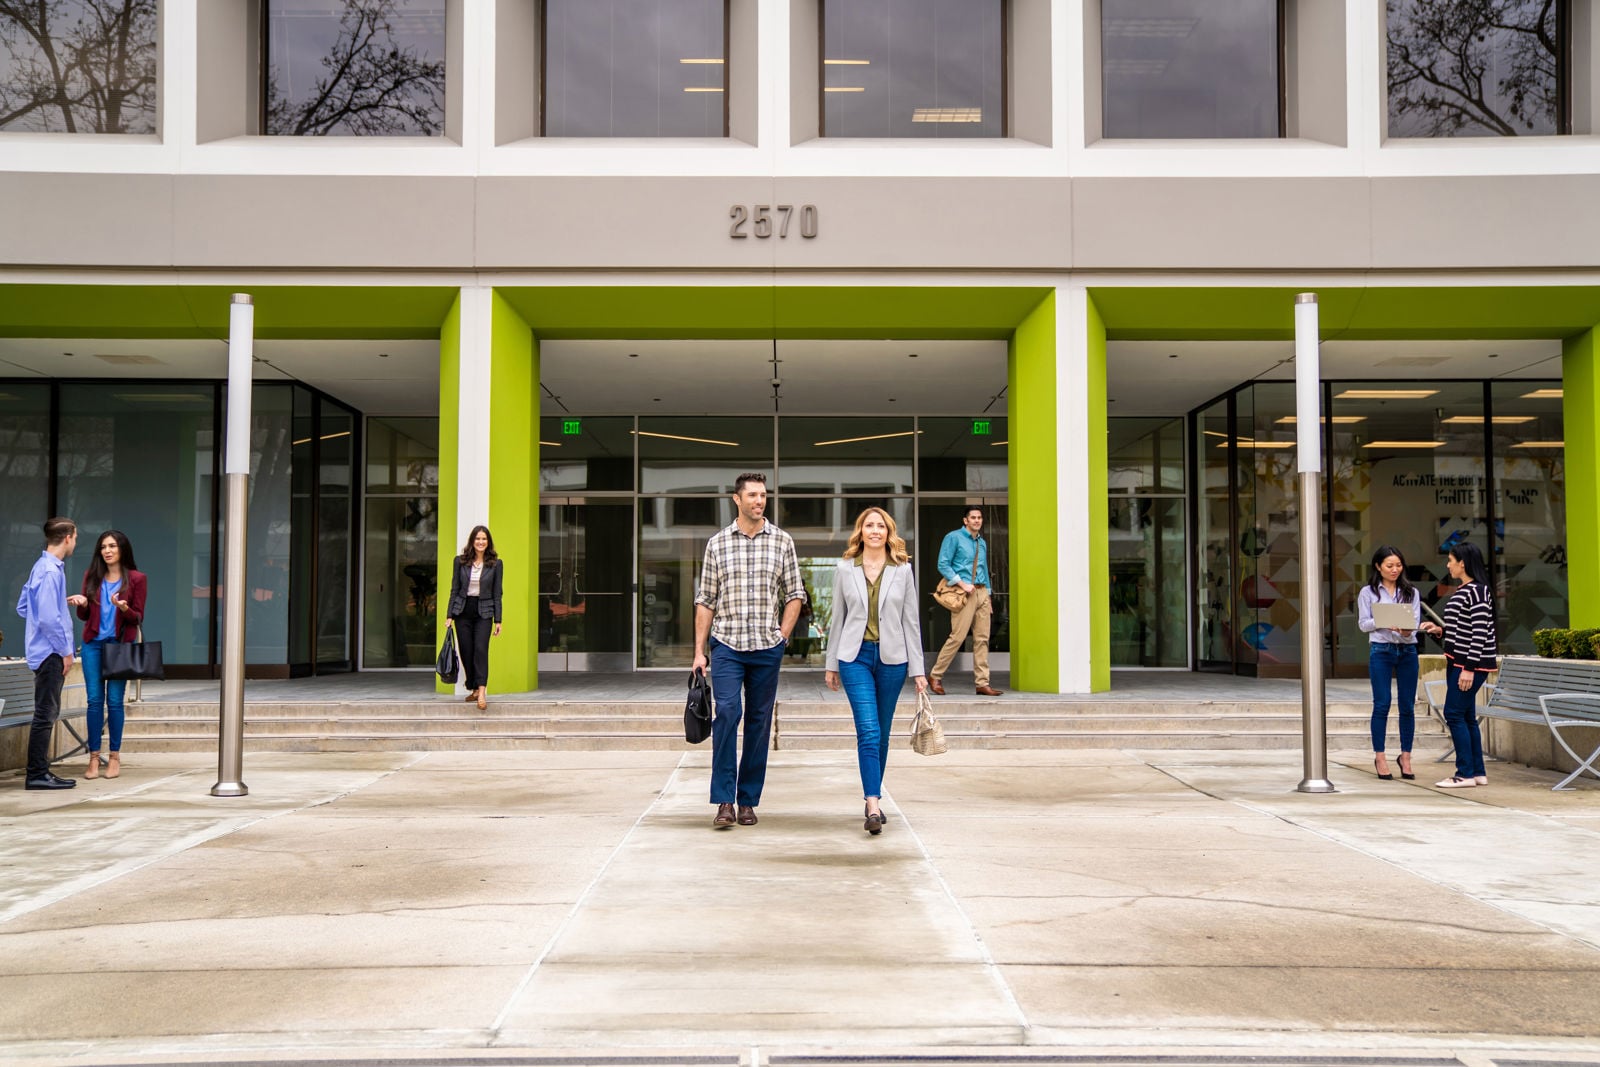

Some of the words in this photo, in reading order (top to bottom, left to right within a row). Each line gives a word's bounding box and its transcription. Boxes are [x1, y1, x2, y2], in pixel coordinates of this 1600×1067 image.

[729, 204, 818, 239] 2570
[564, 421, 580, 435] EXIT
[973, 421, 990, 435] EXIT
[1393, 474, 1436, 487] ACTIVATE
[1439, 474, 1456, 486] THE
[1435, 489, 1475, 504] IGNITE
[1479, 489, 1501, 504] TE
